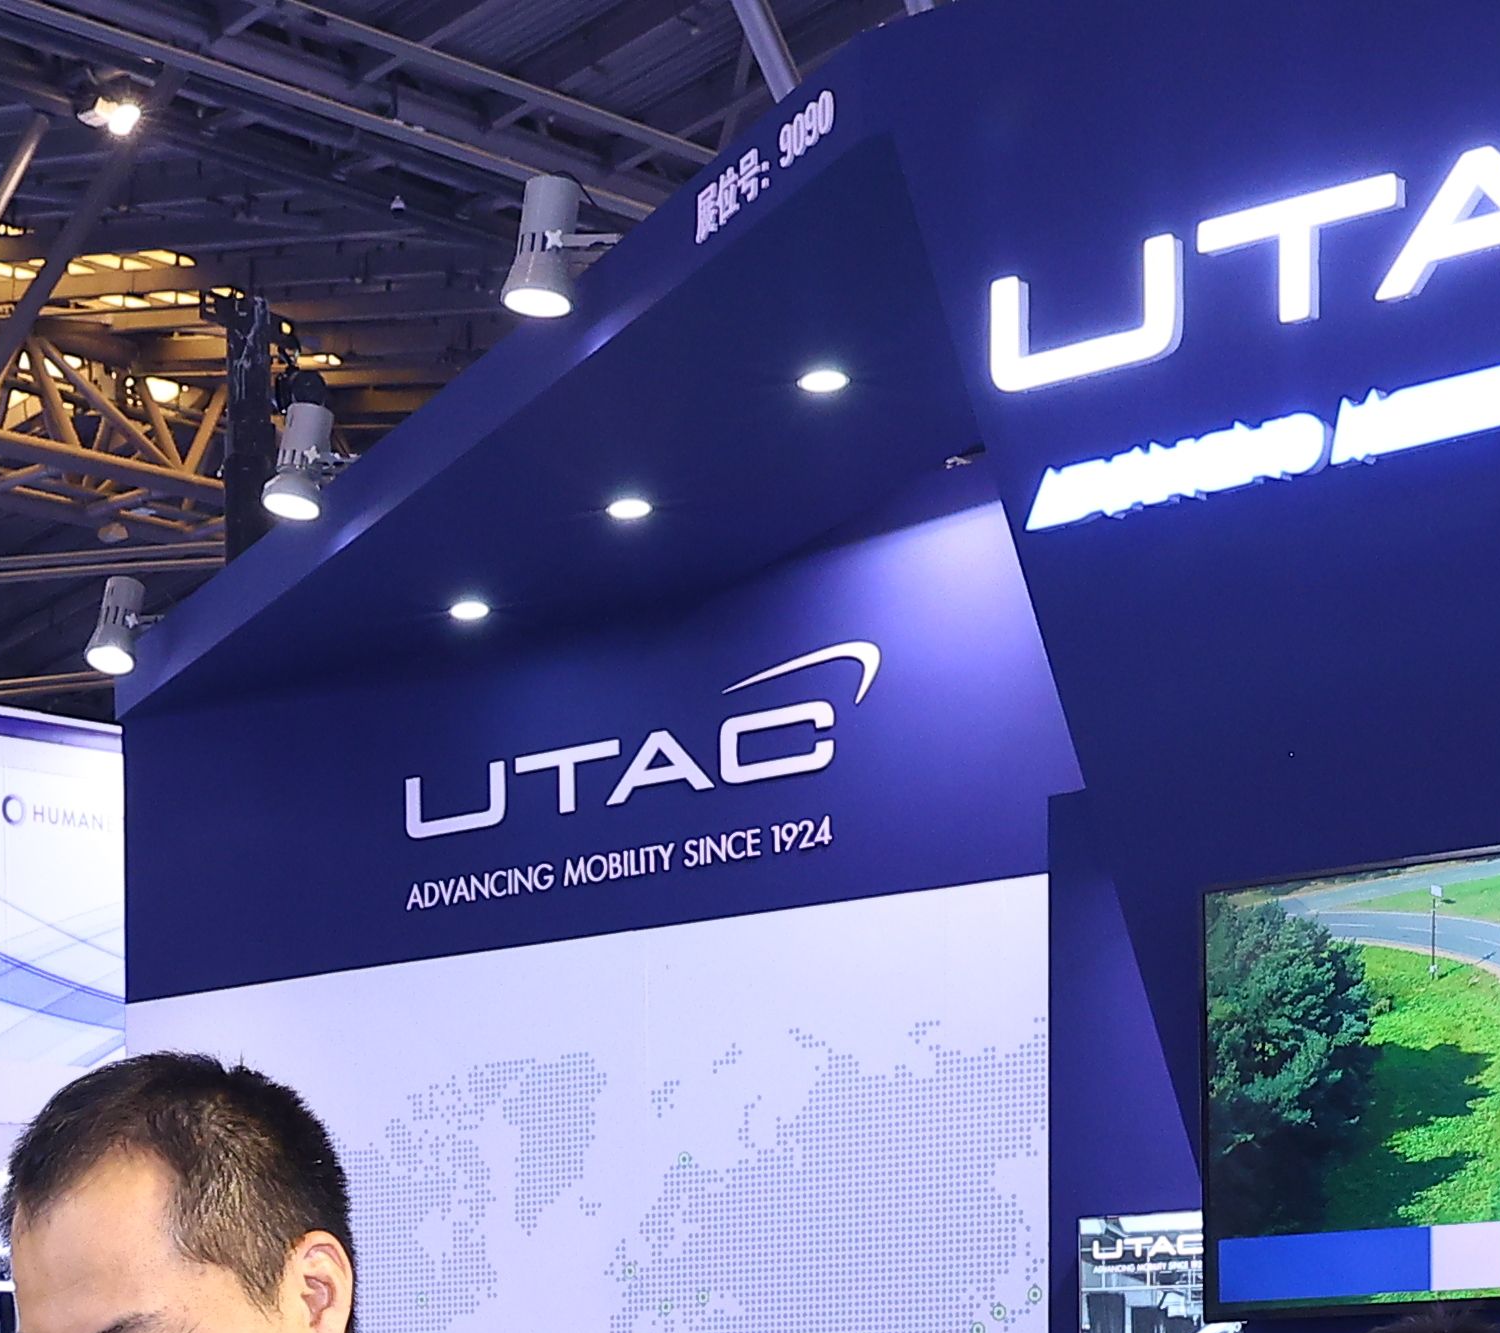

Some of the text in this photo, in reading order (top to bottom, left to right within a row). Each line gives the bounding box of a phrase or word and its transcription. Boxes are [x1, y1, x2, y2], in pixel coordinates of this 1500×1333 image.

[778, 90, 834, 168] 9090
[404, 698, 837, 840] UTAC
[405, 815, 833, 912] ADVANCING MOBILITY SINCE 1924
